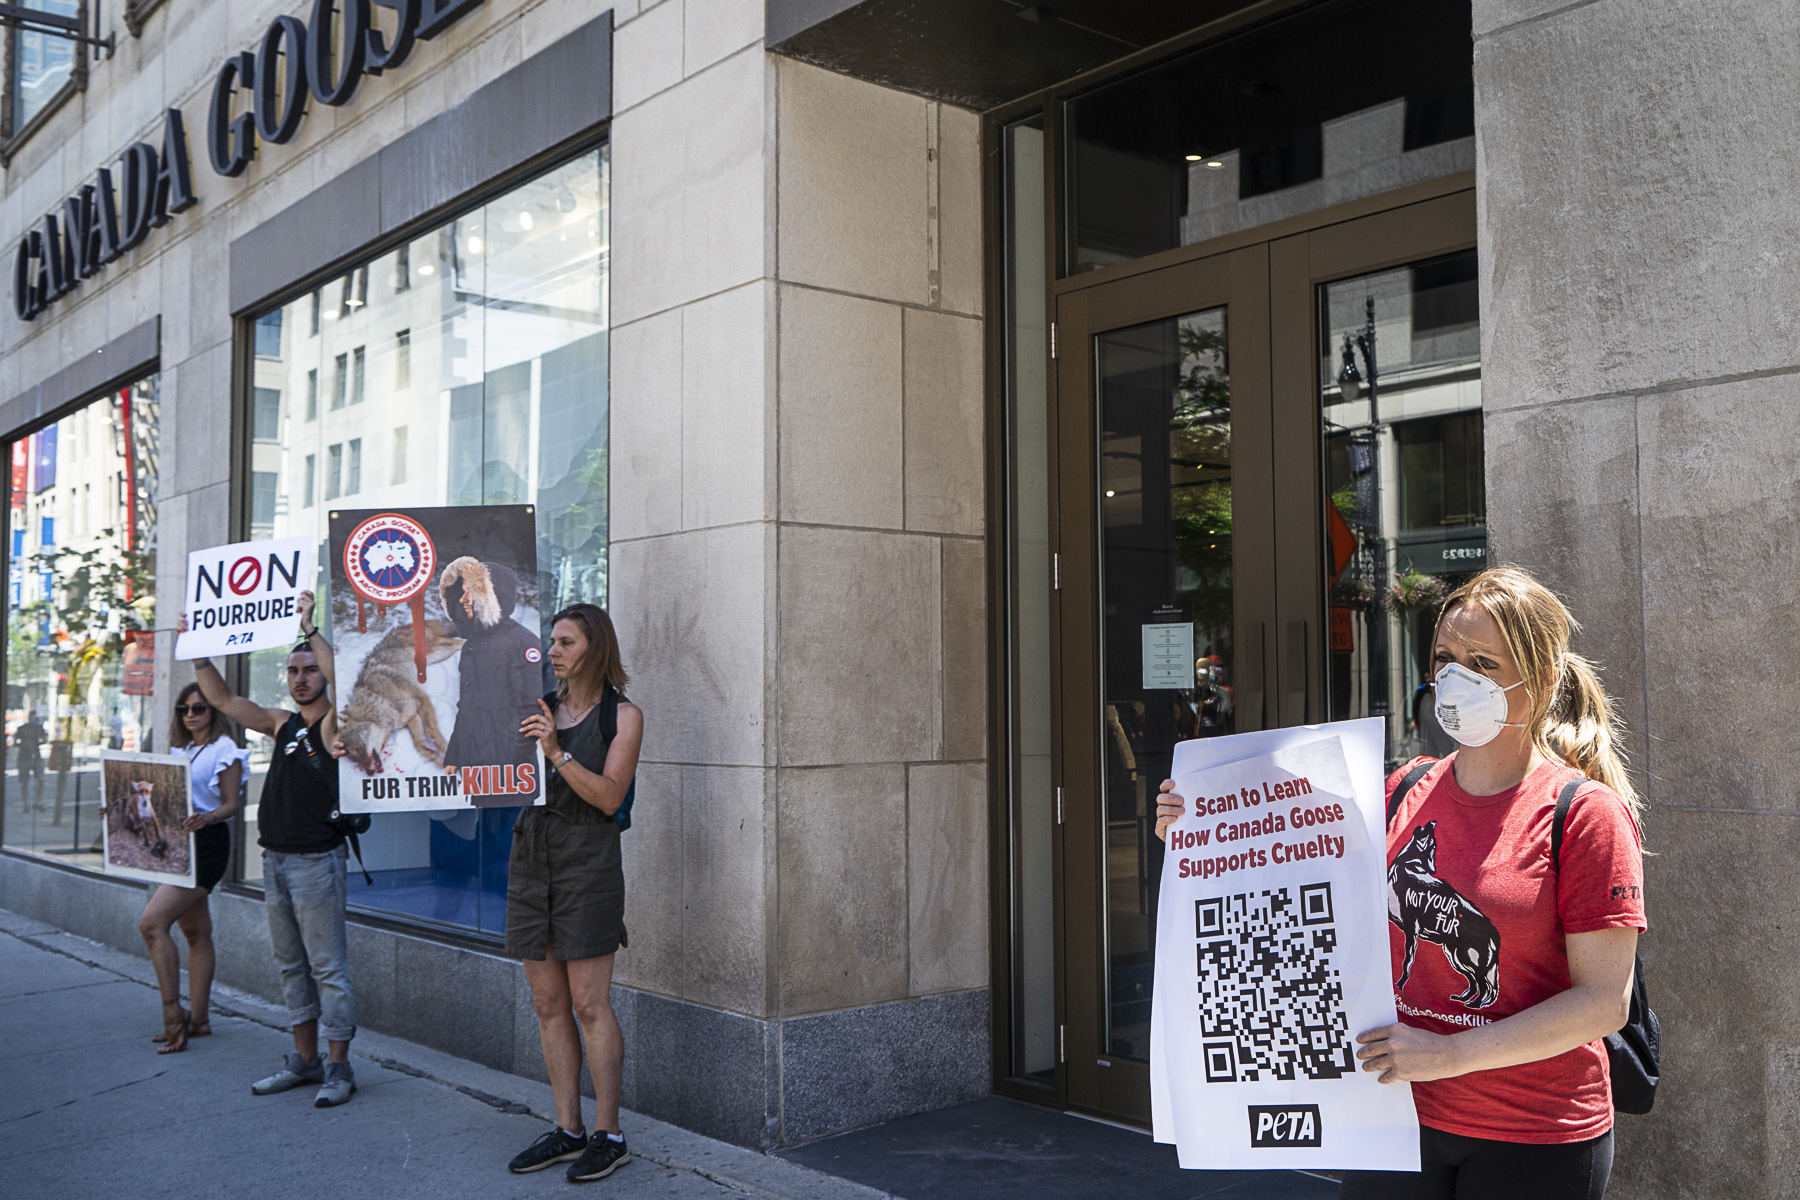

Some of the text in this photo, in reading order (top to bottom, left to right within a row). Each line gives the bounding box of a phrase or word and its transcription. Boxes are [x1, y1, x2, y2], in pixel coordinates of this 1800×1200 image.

[14, 107, 198, 321] CANADA
[357, 520, 387, 540] CANADA
[358, 578, 422, 597] ARCTIC PROGRAM
[192, 596, 295, 631] FOURRURE
[362, 763, 536, 800] FUR TRIM KILLS
[1195, 777, 1313, 818] Scan to Learn
[1171, 803, 1345, 851] How Canada Goose
[1178, 834, 1345, 880] Supports Cruelty
[1405, 887, 1458, 917] NOT YOUR
[1435, 912, 1460, 938] FUR
